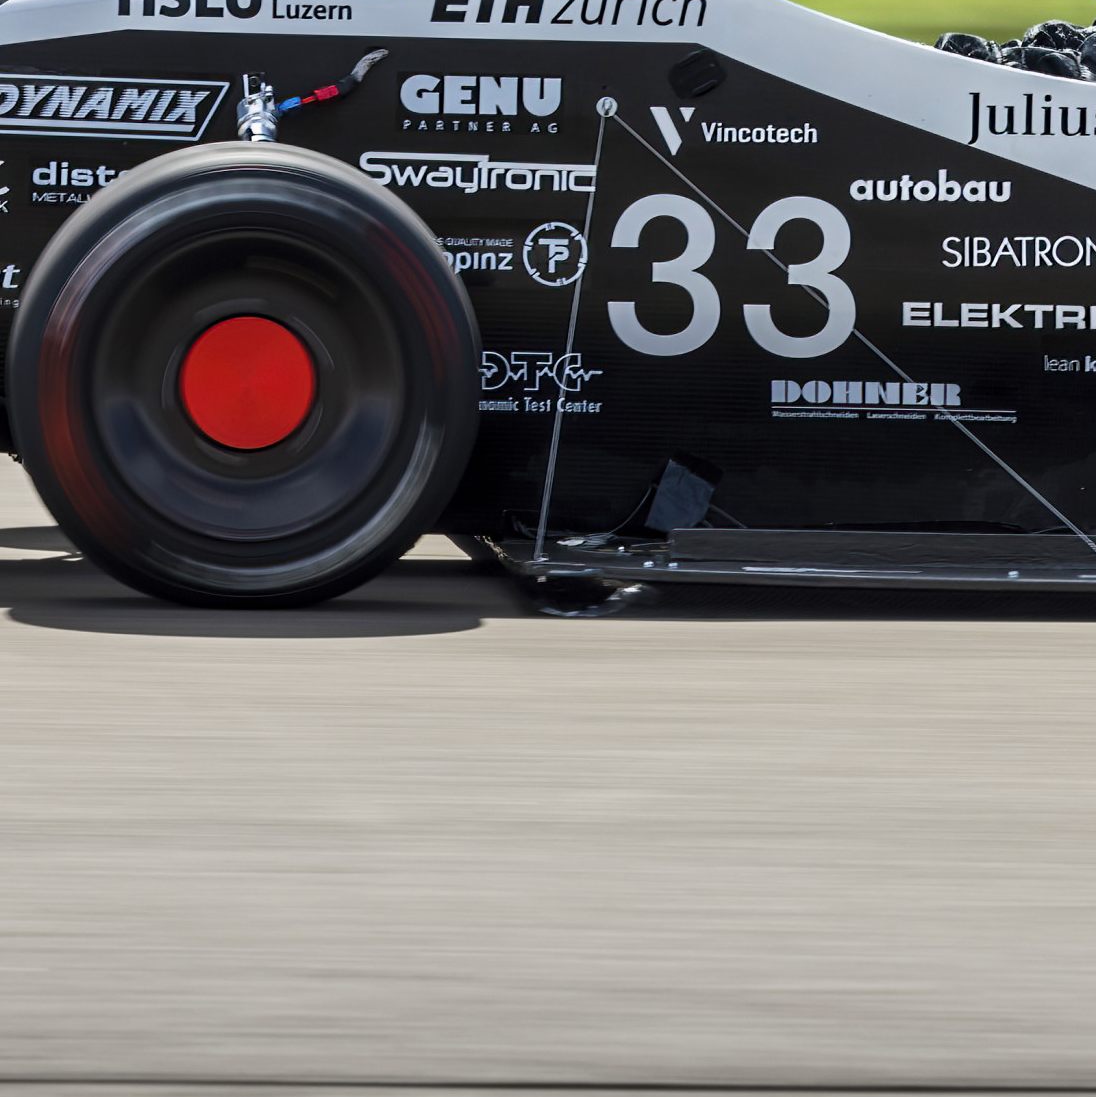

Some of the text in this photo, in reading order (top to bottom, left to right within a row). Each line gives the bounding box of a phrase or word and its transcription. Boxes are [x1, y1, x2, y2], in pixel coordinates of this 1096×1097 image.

[400, 74, 562, 117] GENU
[402, 120, 559, 134] PARTNER AG
[701, 122, 818, 144] Vincotech
[33, 160, 127, 187] dist
[359, 151, 597, 194] Swaytronic
[849, 168, 1012, 202] autobau
[607, 193, 856, 359] 33
[1044, 354, 1081, 372] lean
[524, 397, 551, 412] Test
[556, 398, 603, 413] Center
[771, 380, 961, 406] DOHNER
